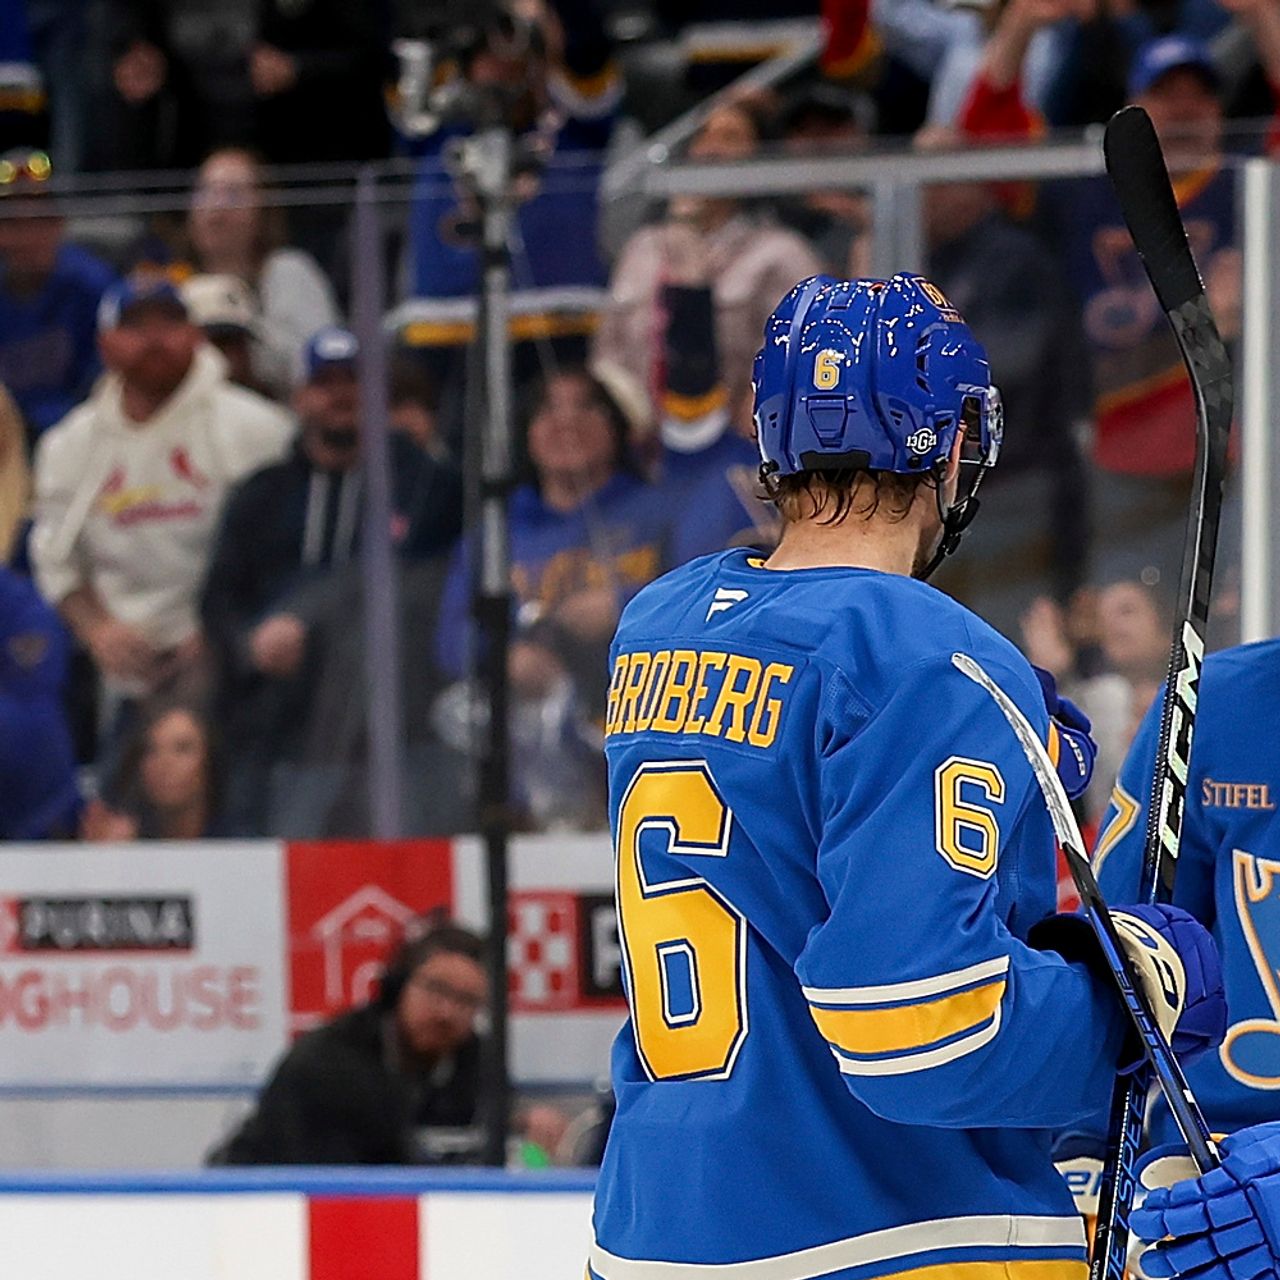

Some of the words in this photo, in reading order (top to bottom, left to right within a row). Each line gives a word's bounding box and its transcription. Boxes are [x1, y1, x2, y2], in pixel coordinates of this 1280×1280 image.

[812, 349, 841, 391] 6
[605, 650, 795, 748] BROBERG
[1159, 620, 1205, 860] CCM
[934, 755, 1006, 879] 6
[1201, 778, 1278, 809] STIFEL
[615, 760, 750, 1082] 6
[0, 967, 262, 1033] GHOUSE
